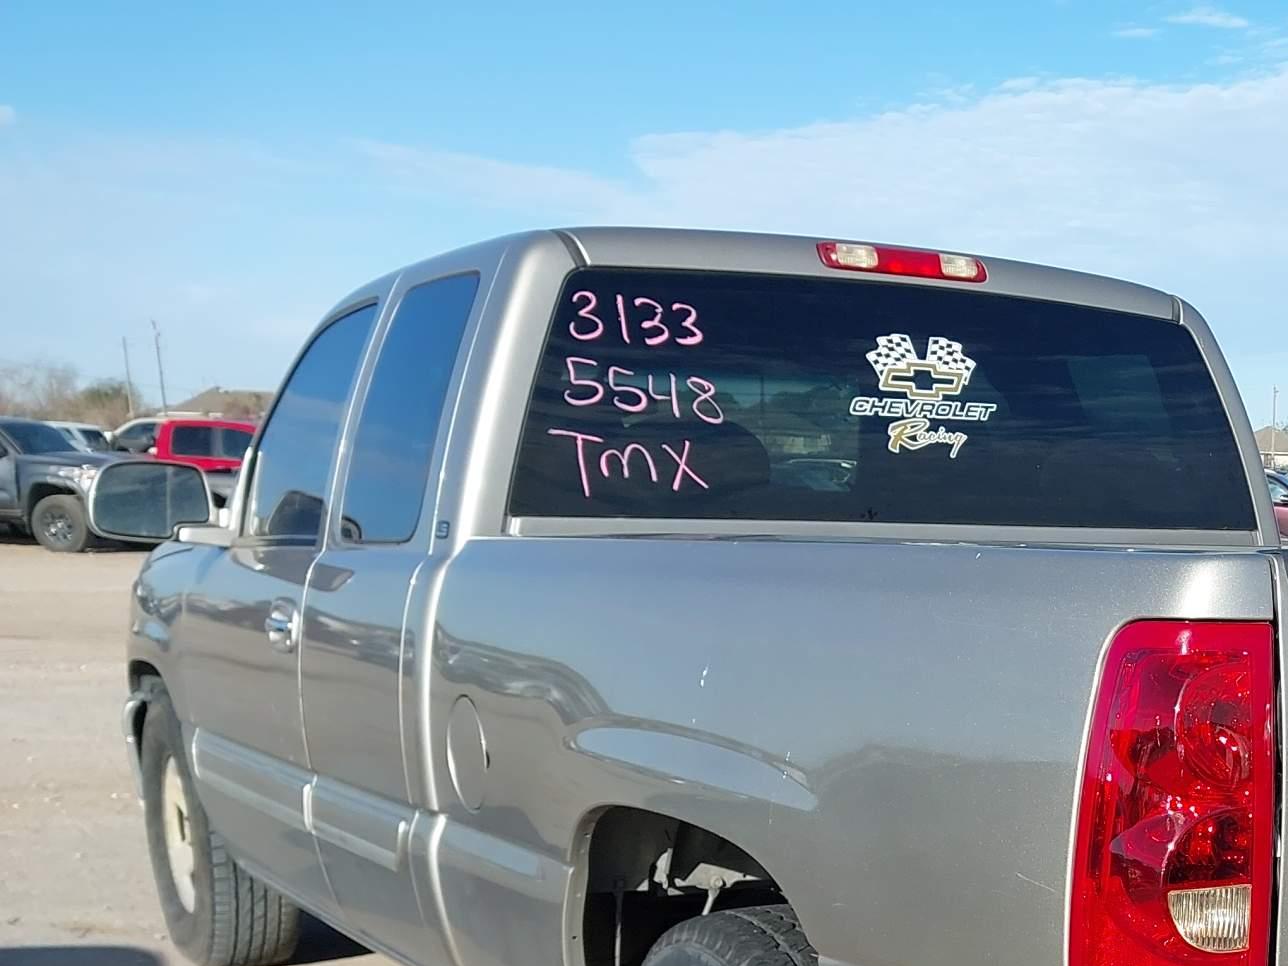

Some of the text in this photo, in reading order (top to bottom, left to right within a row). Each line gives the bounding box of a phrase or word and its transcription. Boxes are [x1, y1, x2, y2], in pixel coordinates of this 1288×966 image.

[569, 290, 704, 346] 3133
[564, 356, 724, 424] 5548
[850, 396, 997, 421] CHEVROLET
[888, 418, 968, 459] Racing
